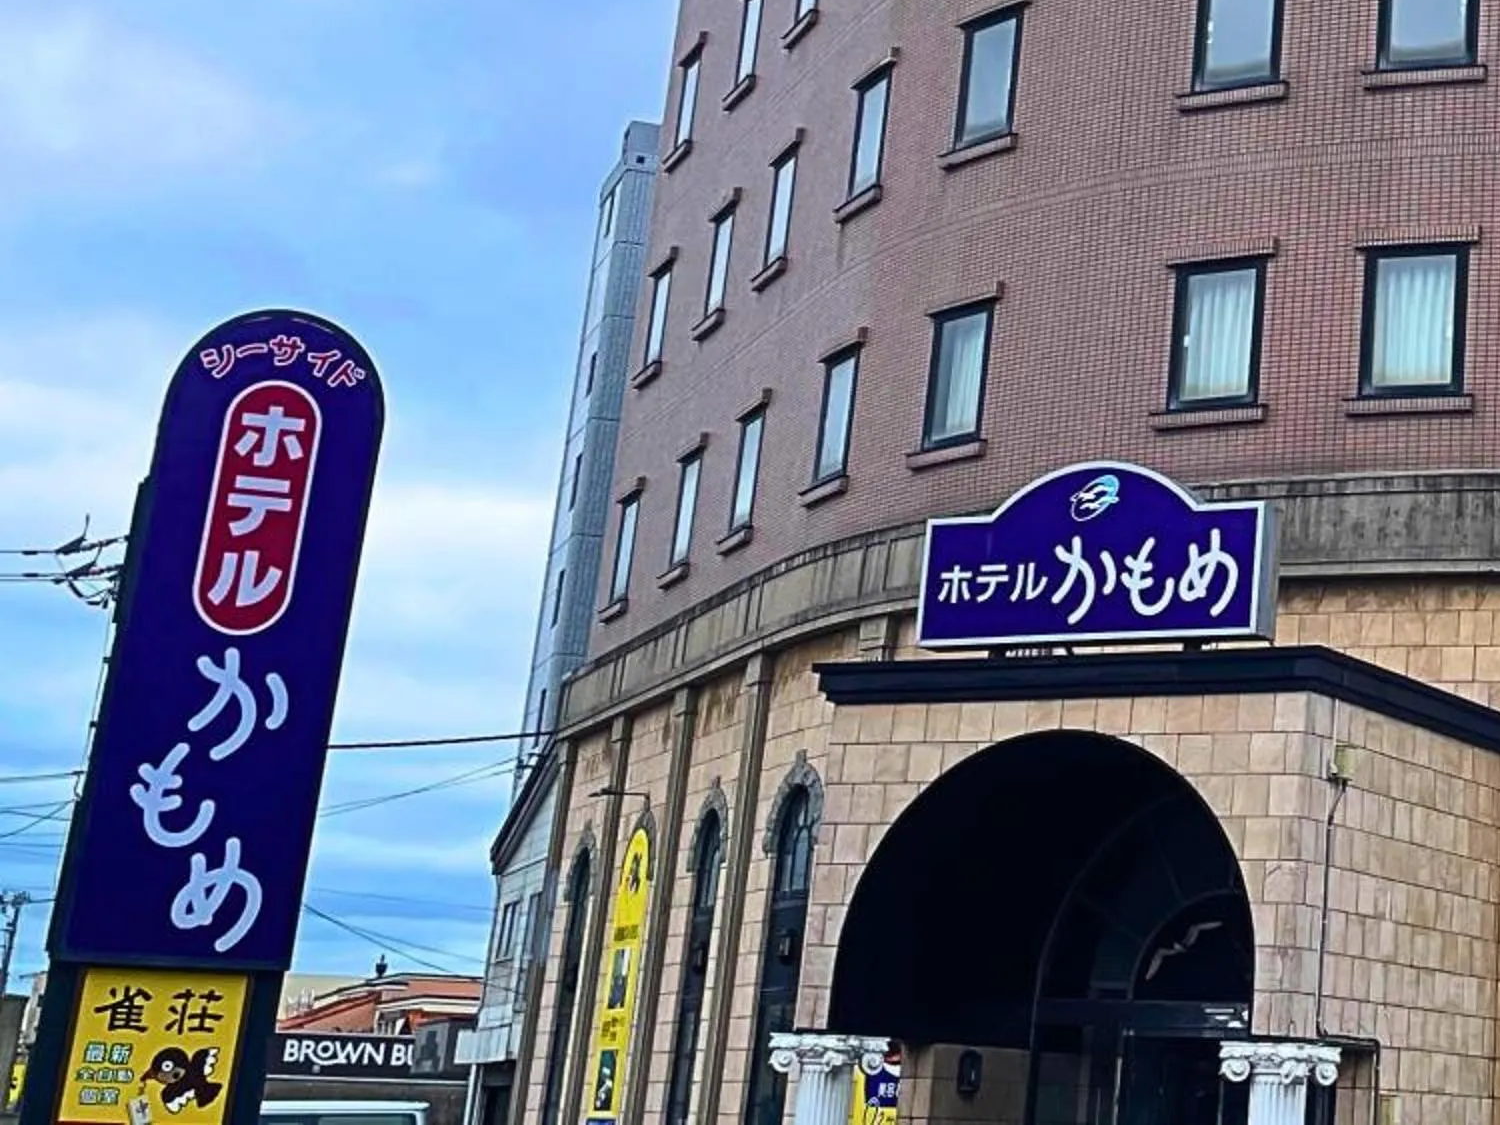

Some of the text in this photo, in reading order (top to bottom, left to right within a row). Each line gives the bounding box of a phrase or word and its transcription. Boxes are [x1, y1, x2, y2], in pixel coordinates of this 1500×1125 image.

[200, 335, 366, 388] シーサイド
[207, 405, 307, 609] ホテル
[130, 647, 289, 954] かもめ
[94, 986, 225, 1035] 雀荘
[84, 1041, 133, 1064] 最新
[283, 1038, 386, 1066] BROWN
